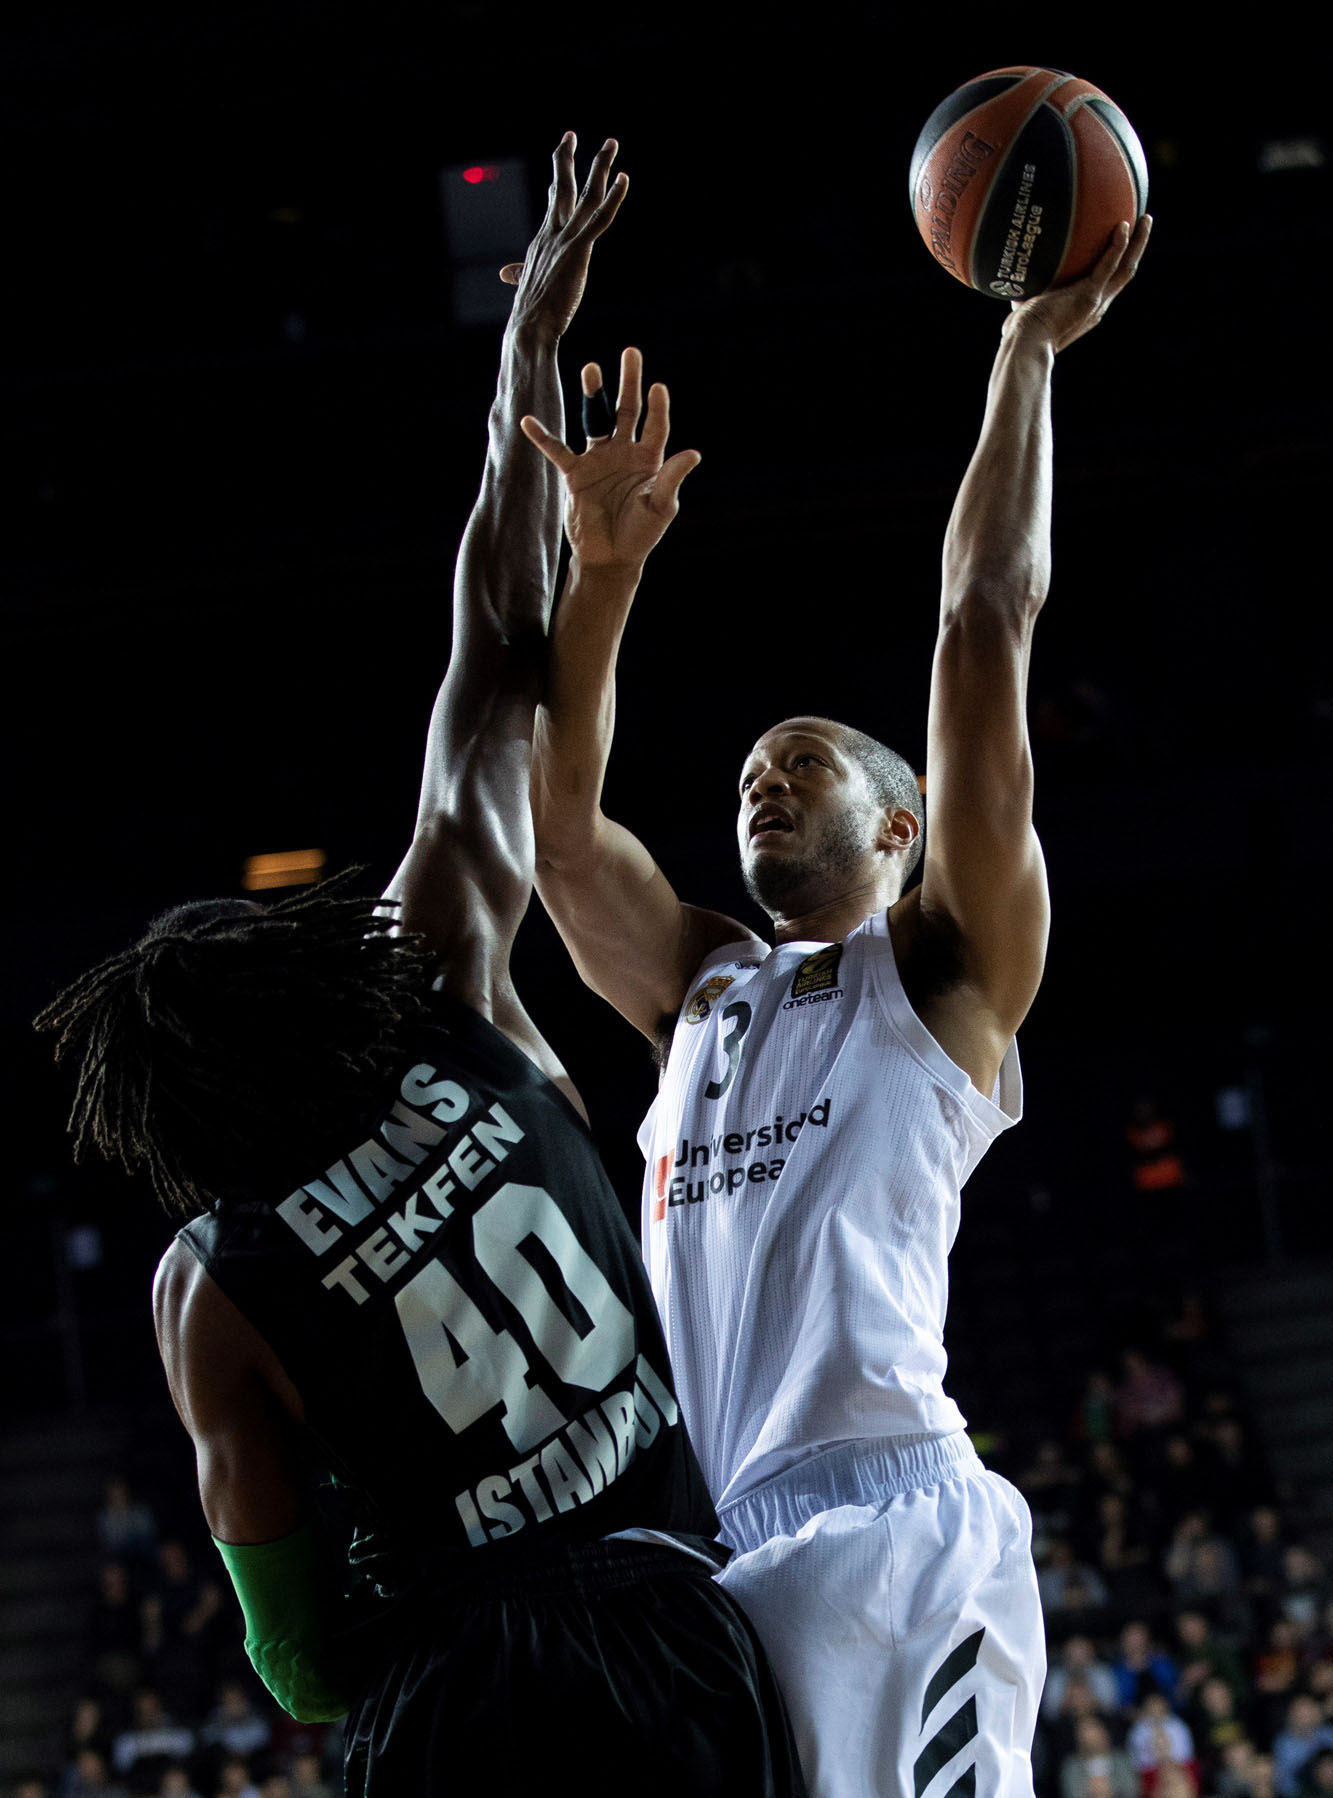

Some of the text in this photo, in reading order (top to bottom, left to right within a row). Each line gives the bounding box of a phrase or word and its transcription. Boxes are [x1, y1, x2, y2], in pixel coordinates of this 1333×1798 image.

[1011, 163, 1036, 229] AIRLINES
[704, 1001, 752, 1100] 3
[275, 1063, 470, 1256] EVANS
[321, 1102, 526, 1305] TEKFEN
[674, 1098, 832, 1168] Unversidd
[394, 1182, 636, 1454] 40
